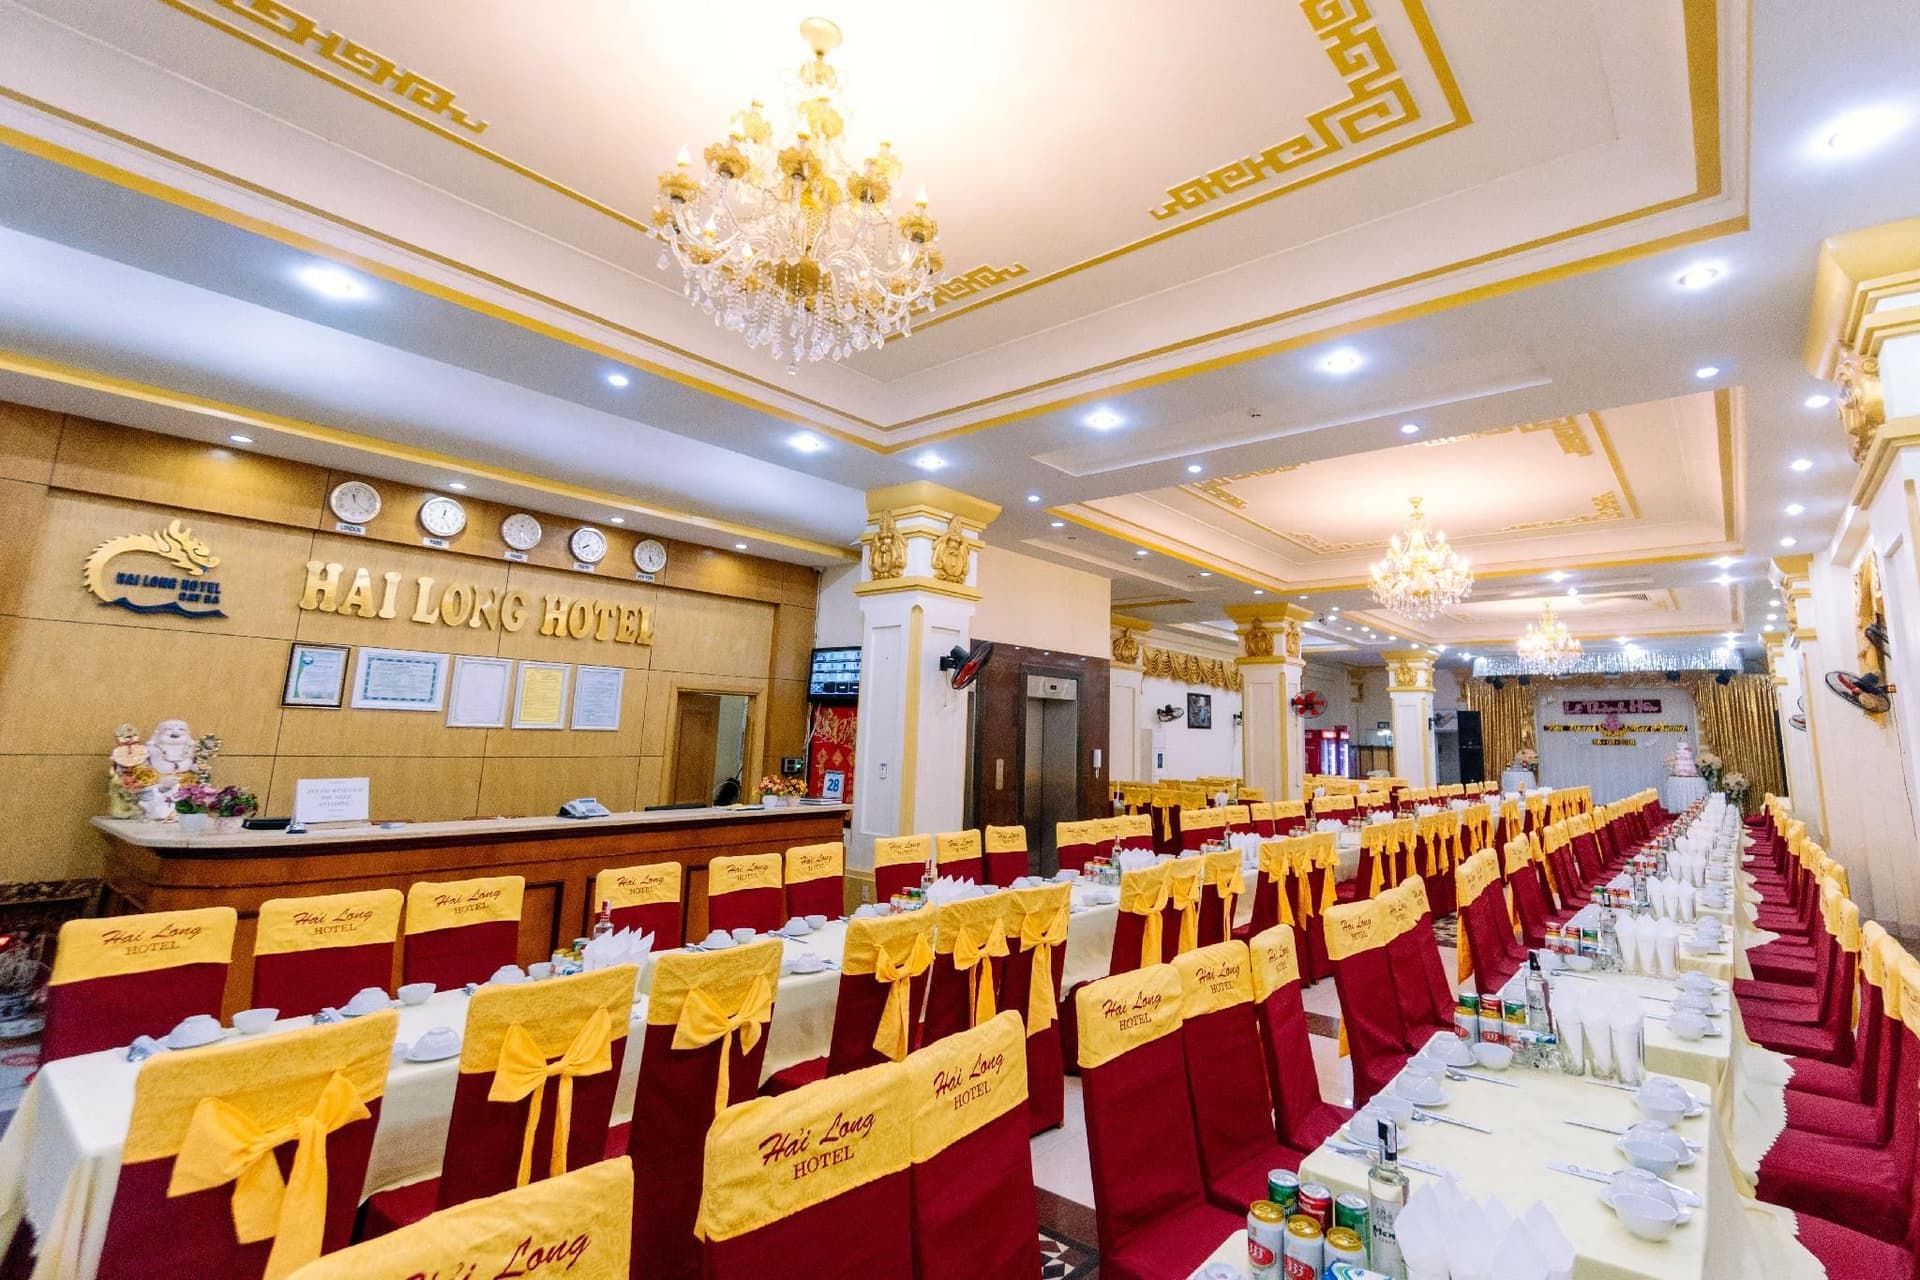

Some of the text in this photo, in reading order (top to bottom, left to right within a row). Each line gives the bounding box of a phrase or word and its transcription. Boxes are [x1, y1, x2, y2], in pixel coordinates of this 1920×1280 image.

[115, 572, 222, 594] HAI LONG HOTEL
[299, 561, 656, 647] HAI LONG HOTEL
[826, 778, 841, 793] 28
[467, 887, 502, 901] Long
[332, 907, 374, 922] Long
[454, 902, 490, 915] HOTEL
[150, 922, 202, 941] Long
[314, 923, 358, 936] HOTEL
[125, 940, 181, 956] HOTEL
[1218, 961, 1241, 979] Long
[1132, 990, 1163, 1010] Long
[1119, 1012, 1152, 1031] HOTEL
[969, 1052, 1004, 1081] Long
[953, 1080, 992, 1111] HOTEL
[819, 1111, 876, 1146] Long
[793, 1144, 855, 1181] HOTEL
[492, 1232, 591, 1280] Long
